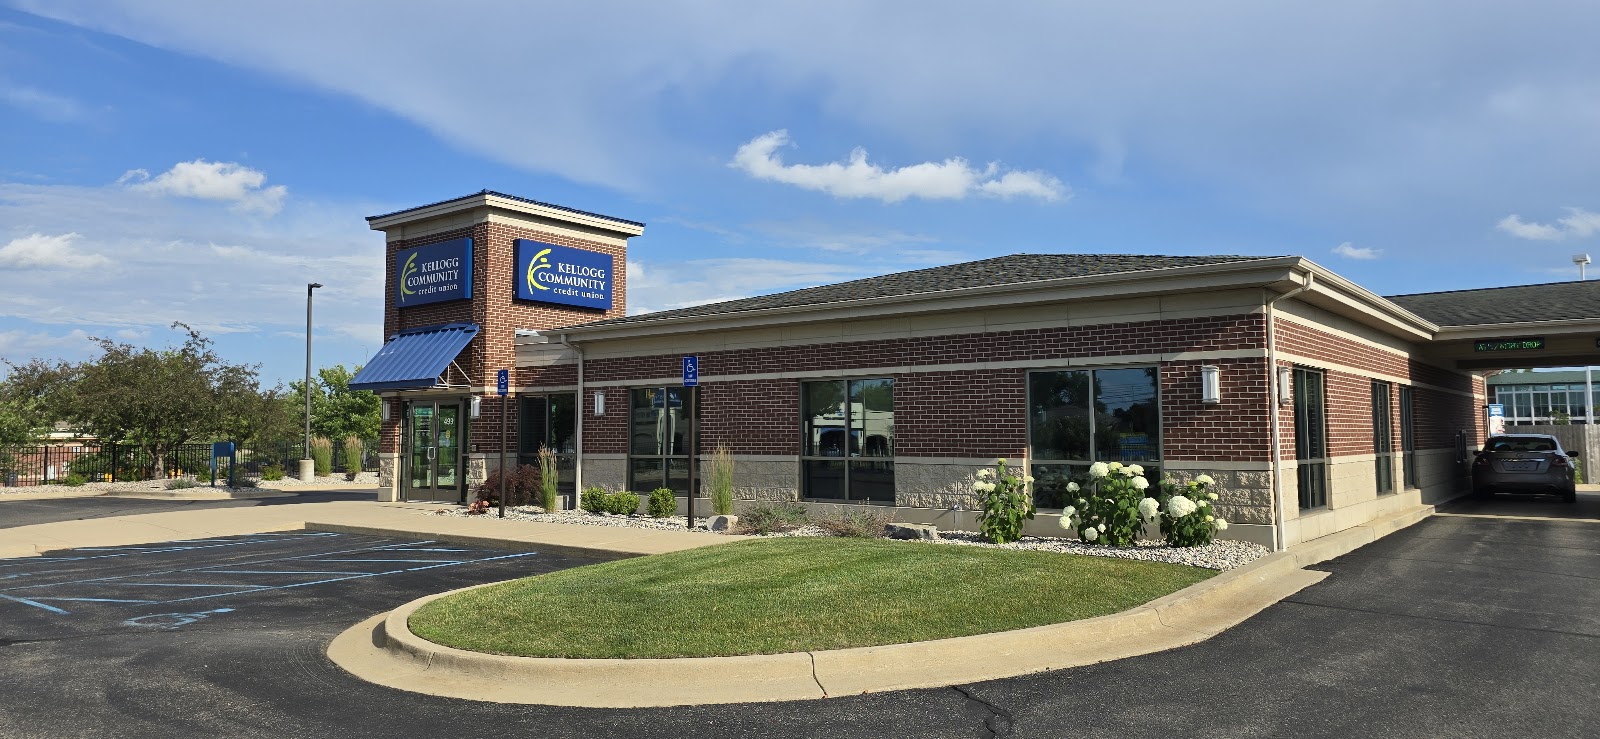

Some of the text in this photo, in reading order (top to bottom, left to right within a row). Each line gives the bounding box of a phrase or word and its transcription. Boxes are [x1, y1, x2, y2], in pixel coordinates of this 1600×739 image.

[421, 257, 459, 273] KELLOGG
[558, 262, 605, 279] KELLOGG
[407, 269, 459, 287] COMMUNITY
[538, 271, 606, 290] COMMUNITY
[418, 283, 458, 295] credit union
[553, 287, 605, 300] credit union
